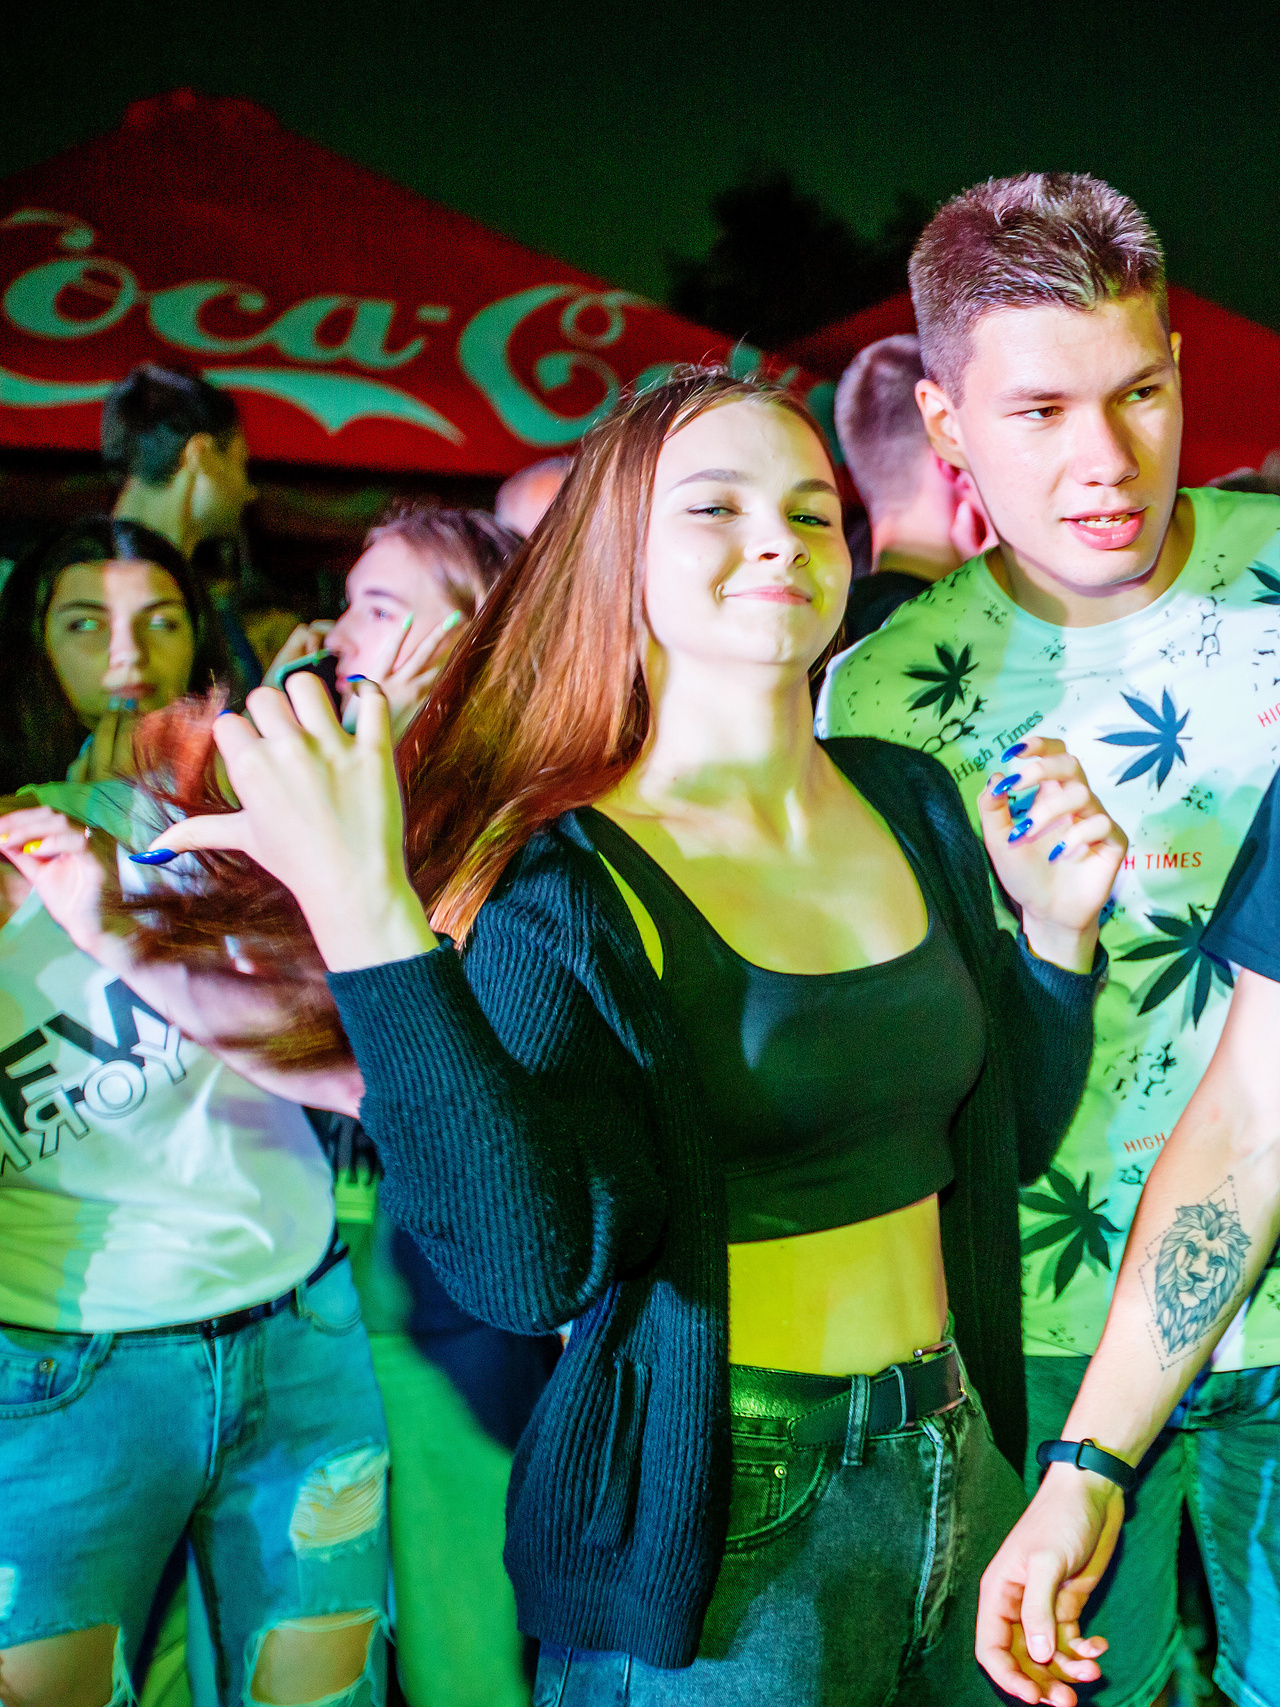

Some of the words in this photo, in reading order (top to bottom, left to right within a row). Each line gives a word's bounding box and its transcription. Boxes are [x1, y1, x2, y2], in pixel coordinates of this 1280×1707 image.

[953, 748, 994, 782] High
[992, 710, 1044, 750] Times
[1145, 851, 1202, 870] TIMES
[1123, 1132, 1166, 1154] HIGH
